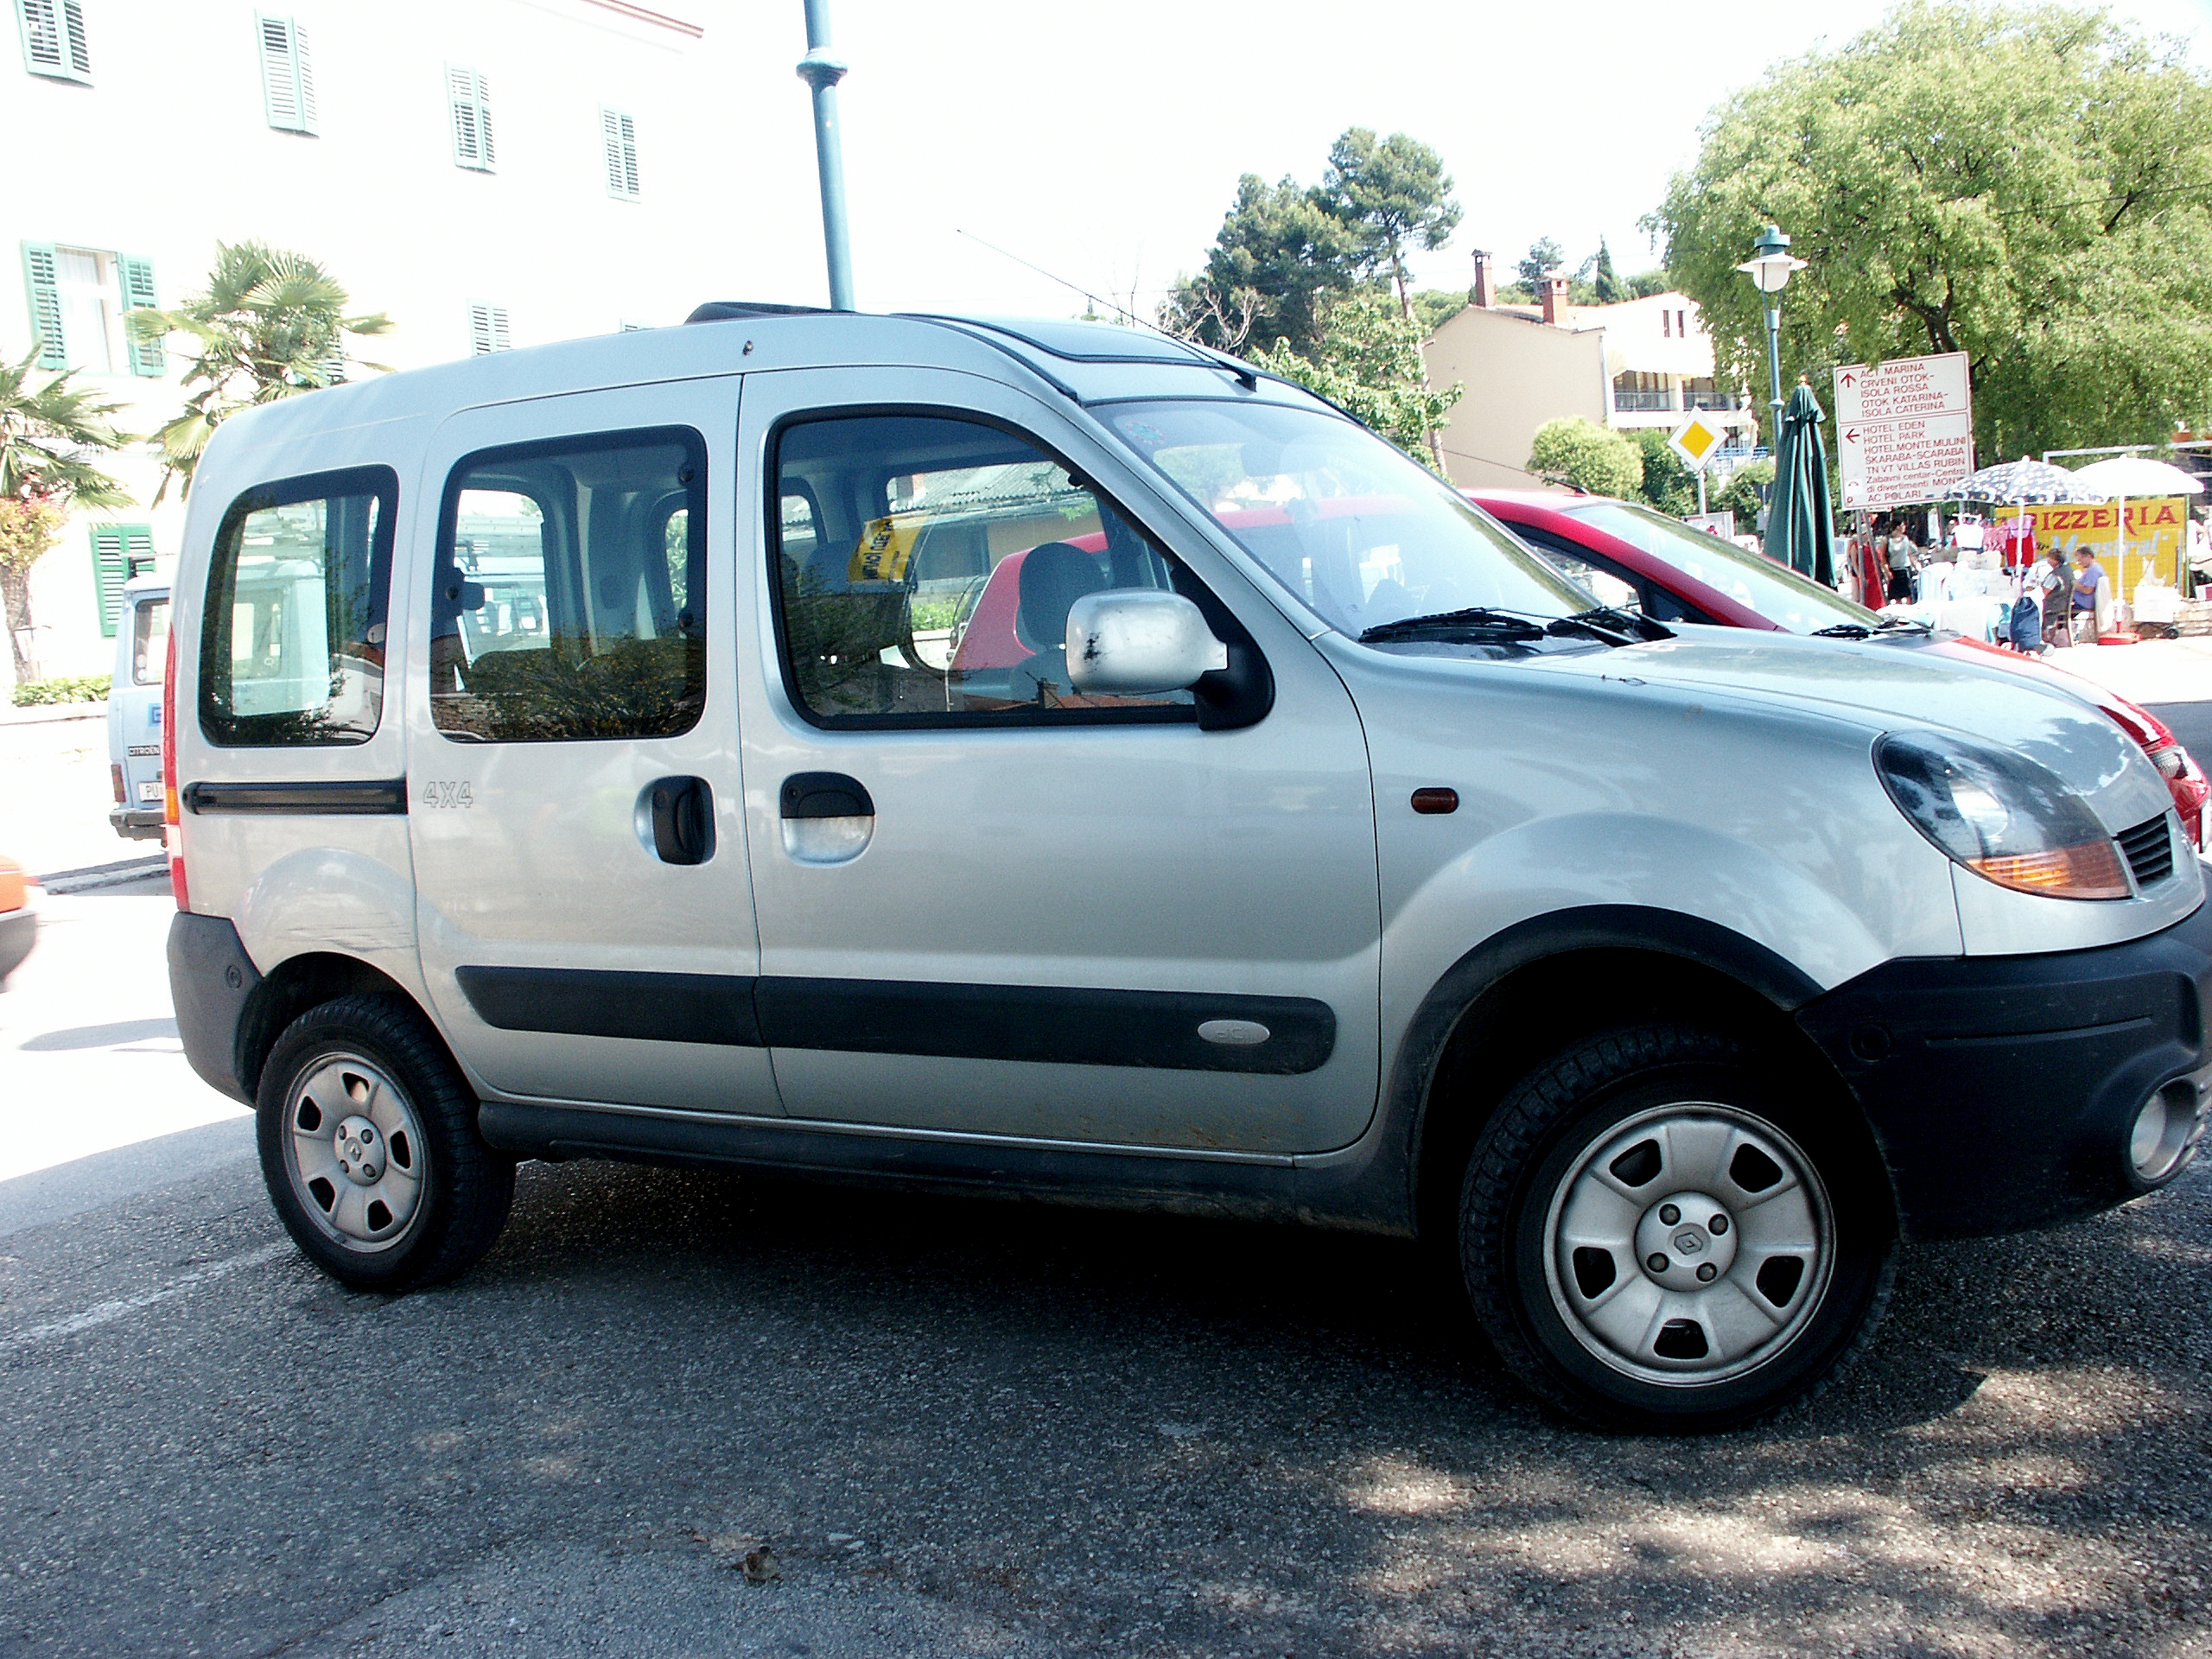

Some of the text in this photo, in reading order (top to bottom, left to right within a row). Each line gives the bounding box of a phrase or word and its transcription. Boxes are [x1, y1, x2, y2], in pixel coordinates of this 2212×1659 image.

[1884, 363, 1924, 375] MARINA
[1860, 378, 1897, 389] CRVENI
[1860, 383, 1929, 398] ISOLA ROSSA
[1861, 398, 1889, 409] OTOK
[1861, 401, 1945, 417] ISOLA CATERINA
[1863, 421, 1925, 435] HOTEL EDEN
[1863, 431, 1926, 444] HOTEL PARK
[1864, 436, 1966, 454] HOTEL MONTE MULINI
[1897, 461, 1931, 471] VILLAS
[1934, 457, 1965, 467] RUBIN
[1878, 480, 1929, 493] divertimenti
[1868, 493, 1881, 502] AC
[1885, 490, 1921, 500] POLARI
